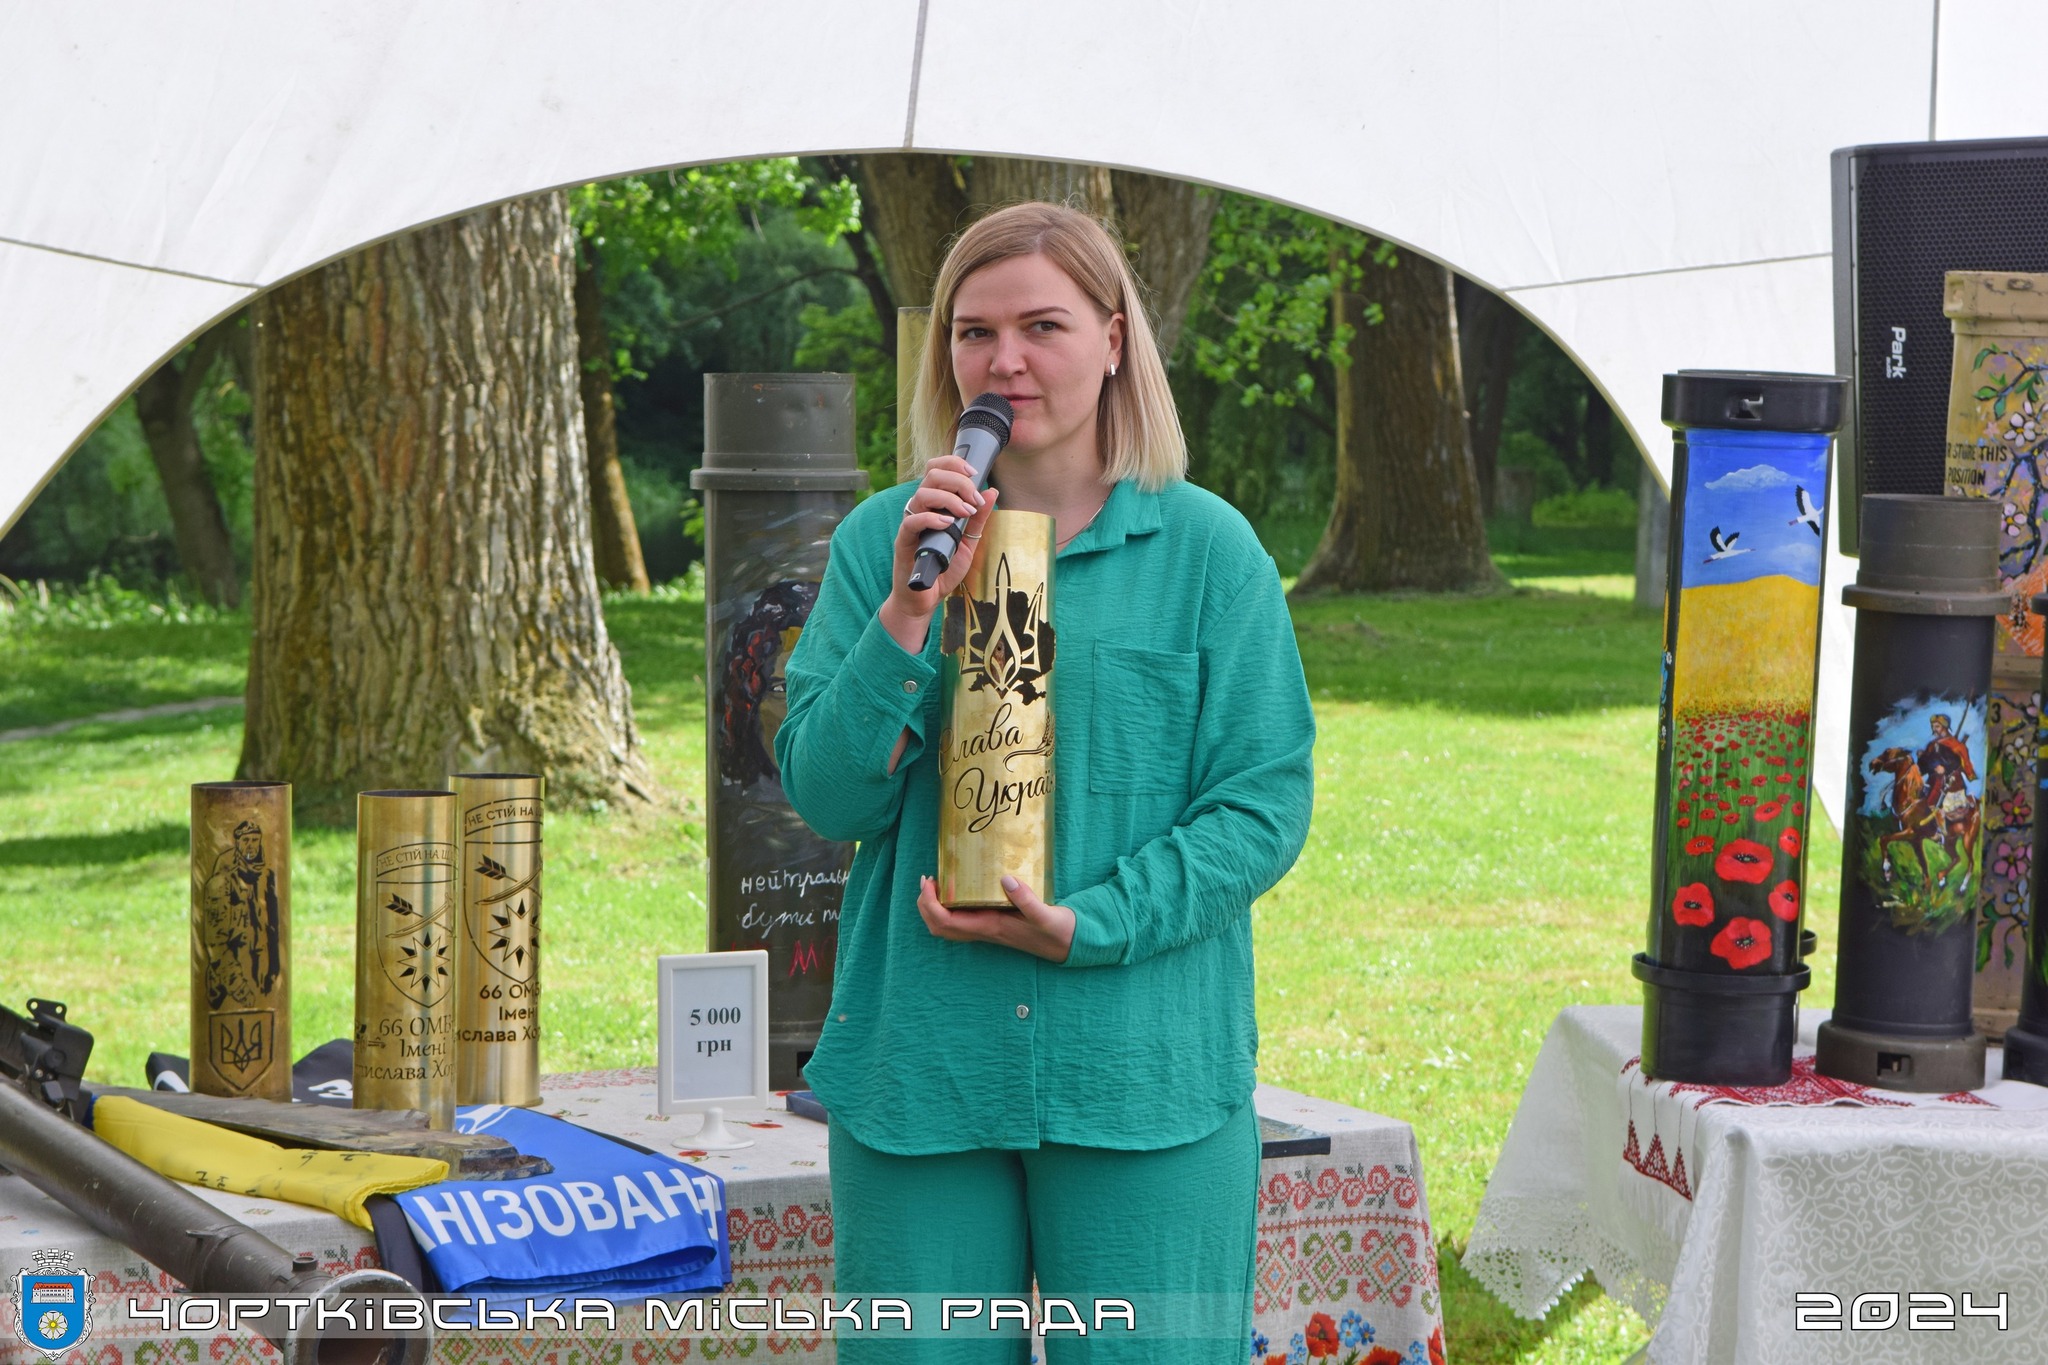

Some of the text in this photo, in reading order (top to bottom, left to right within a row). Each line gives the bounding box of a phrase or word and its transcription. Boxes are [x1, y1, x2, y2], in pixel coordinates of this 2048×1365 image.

[1891, 326, 1907, 378] Park
[1979, 445, 2007, 461] THIS
[467, 813, 483, 826] НЕ
[486, 805, 516, 820] СТІЙ
[520, 807, 534, 816] НА
[380, 855, 394, 869] НЕ
[396, 848, 421, 863] СТІЙ
[425, 849, 439, 860] НА
[480, 984, 502, 999] 66
[690, 1006, 741, 1026] 5 000
[379, 1019, 402, 1036] 66
[400, 1037, 446, 1057] Імені
[697, 1039, 731, 1057] грн
